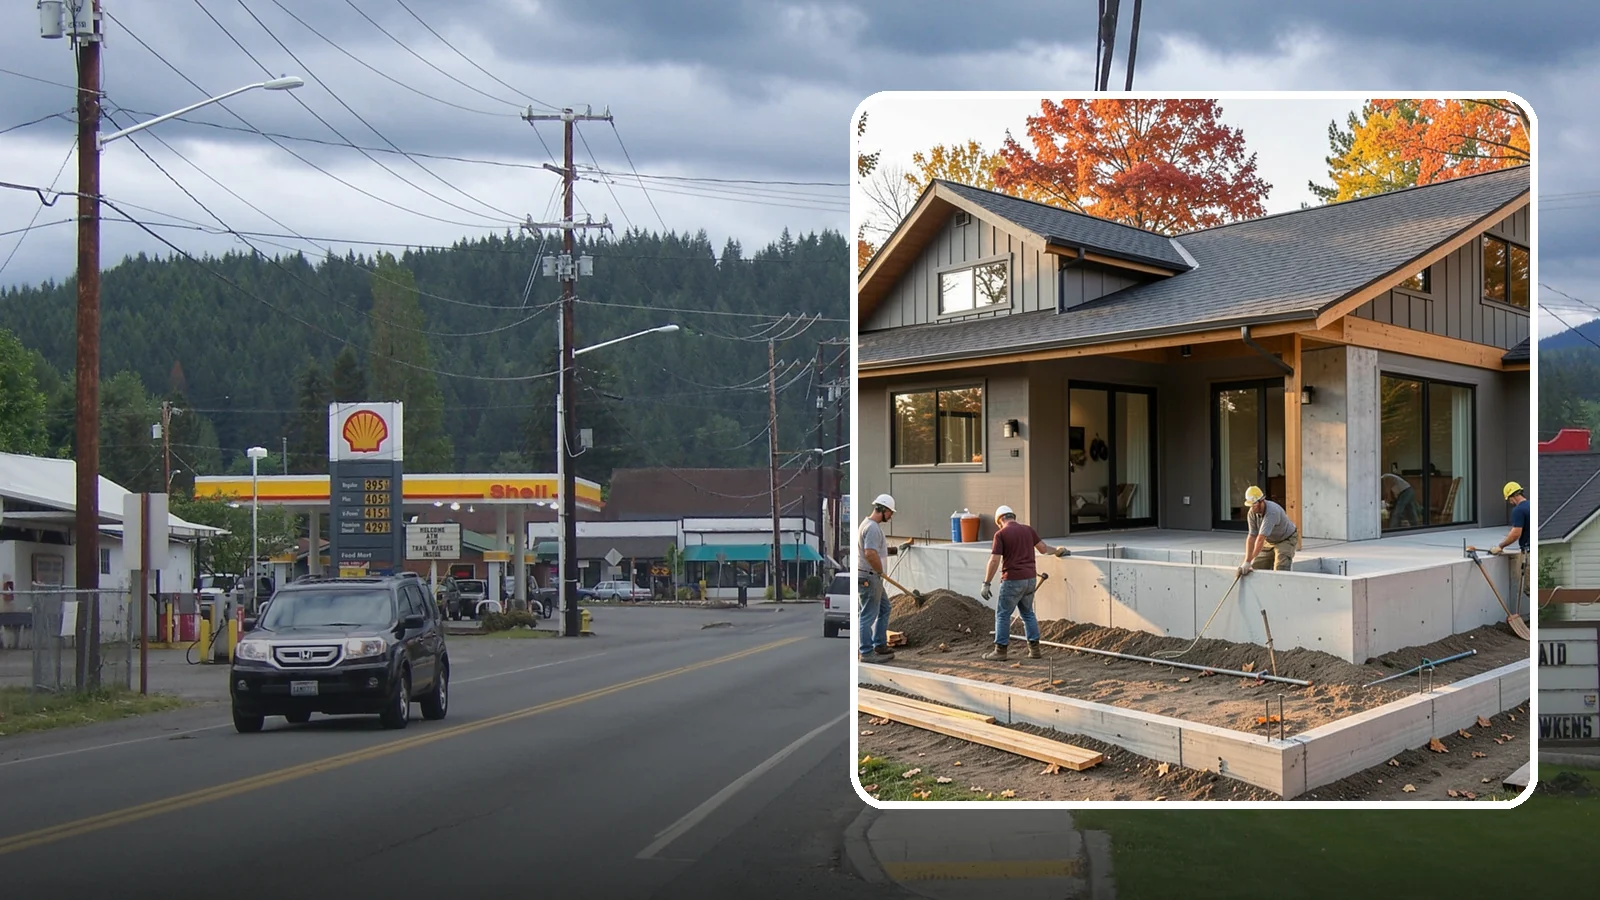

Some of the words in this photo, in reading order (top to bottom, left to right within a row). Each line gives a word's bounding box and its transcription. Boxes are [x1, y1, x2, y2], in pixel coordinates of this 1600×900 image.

[365, 480, 383, 490] 395
[490, 484, 547, 499] Shell
[365, 494, 383, 504] 405
[365, 508, 383, 518] 415
[365, 522, 383, 532] 429
